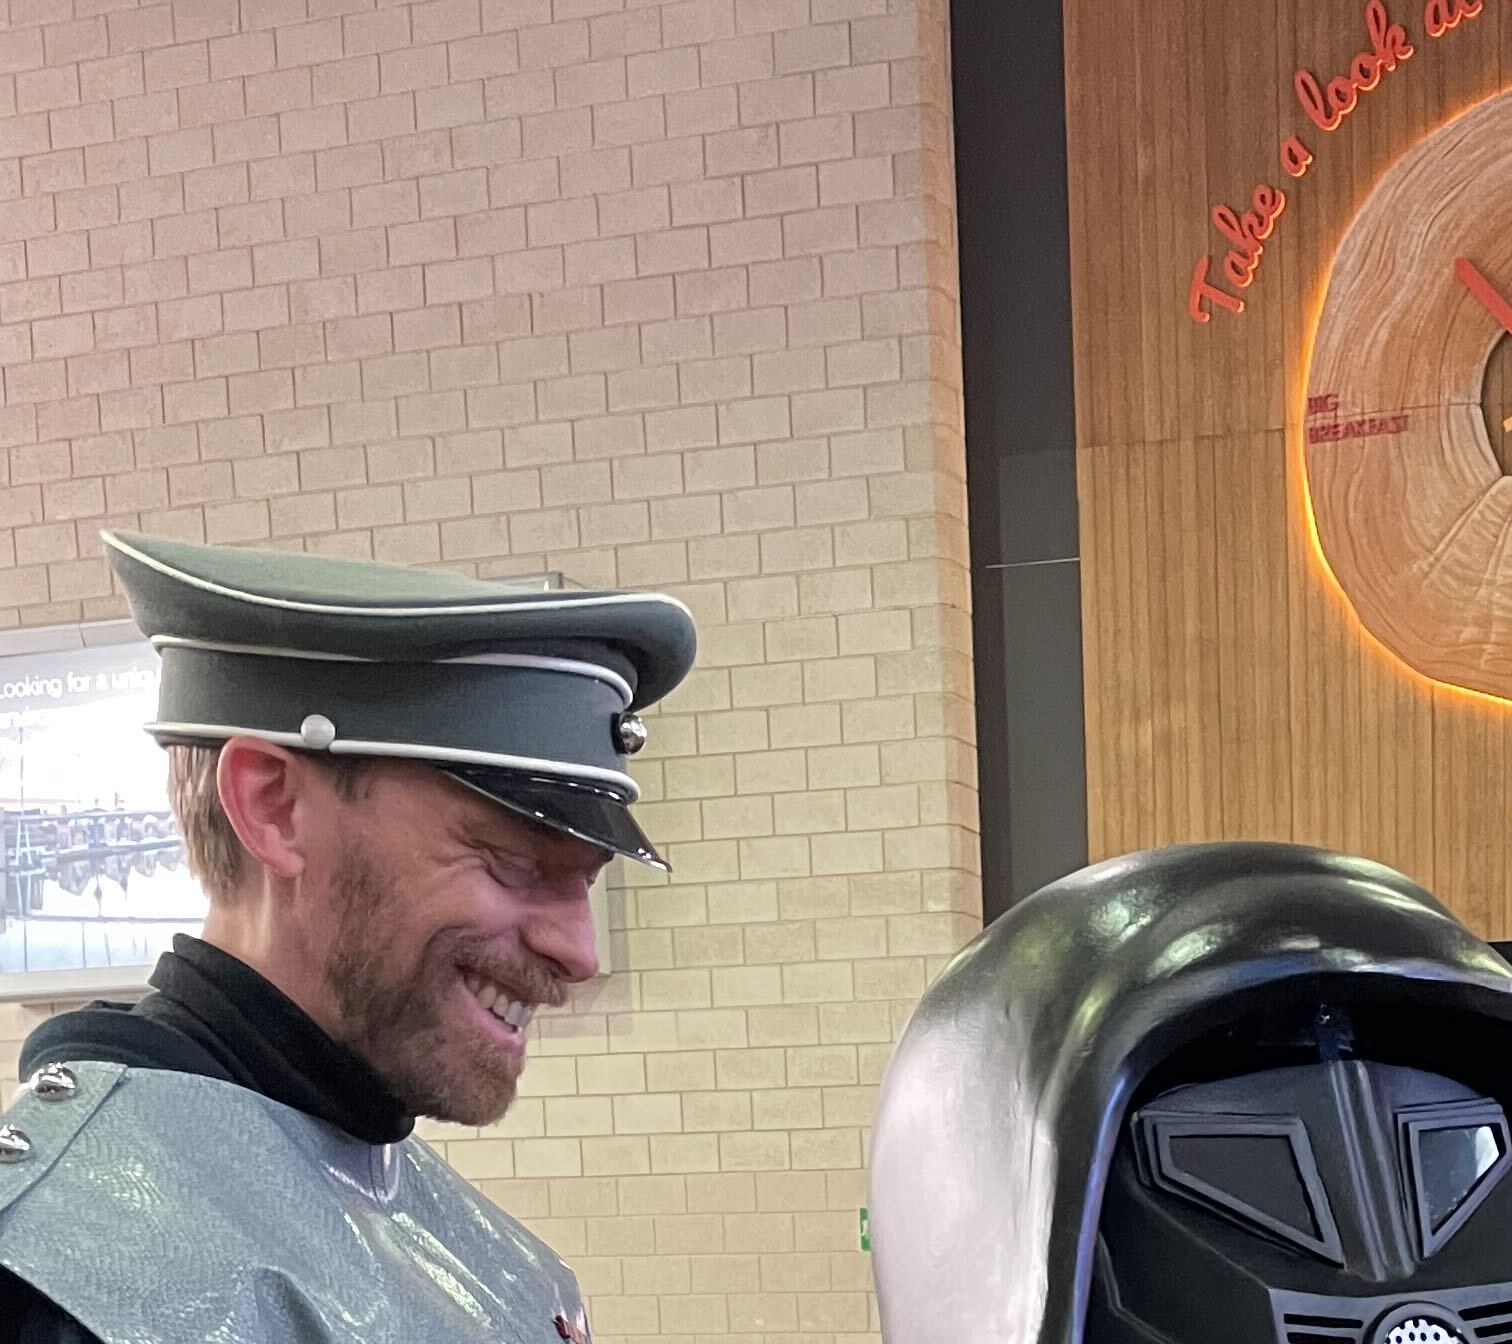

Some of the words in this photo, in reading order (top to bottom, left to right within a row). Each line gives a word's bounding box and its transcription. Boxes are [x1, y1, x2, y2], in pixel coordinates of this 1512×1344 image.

[1295, 0, 1414, 131] look
[1281, 136, 1313, 177] a
[1189, 183, 1286, 322] Take
[1309, 415, 1408, 444] BREAKFAST
[67, 671, 91, 692] for
[96, 673, 108, 691] a
